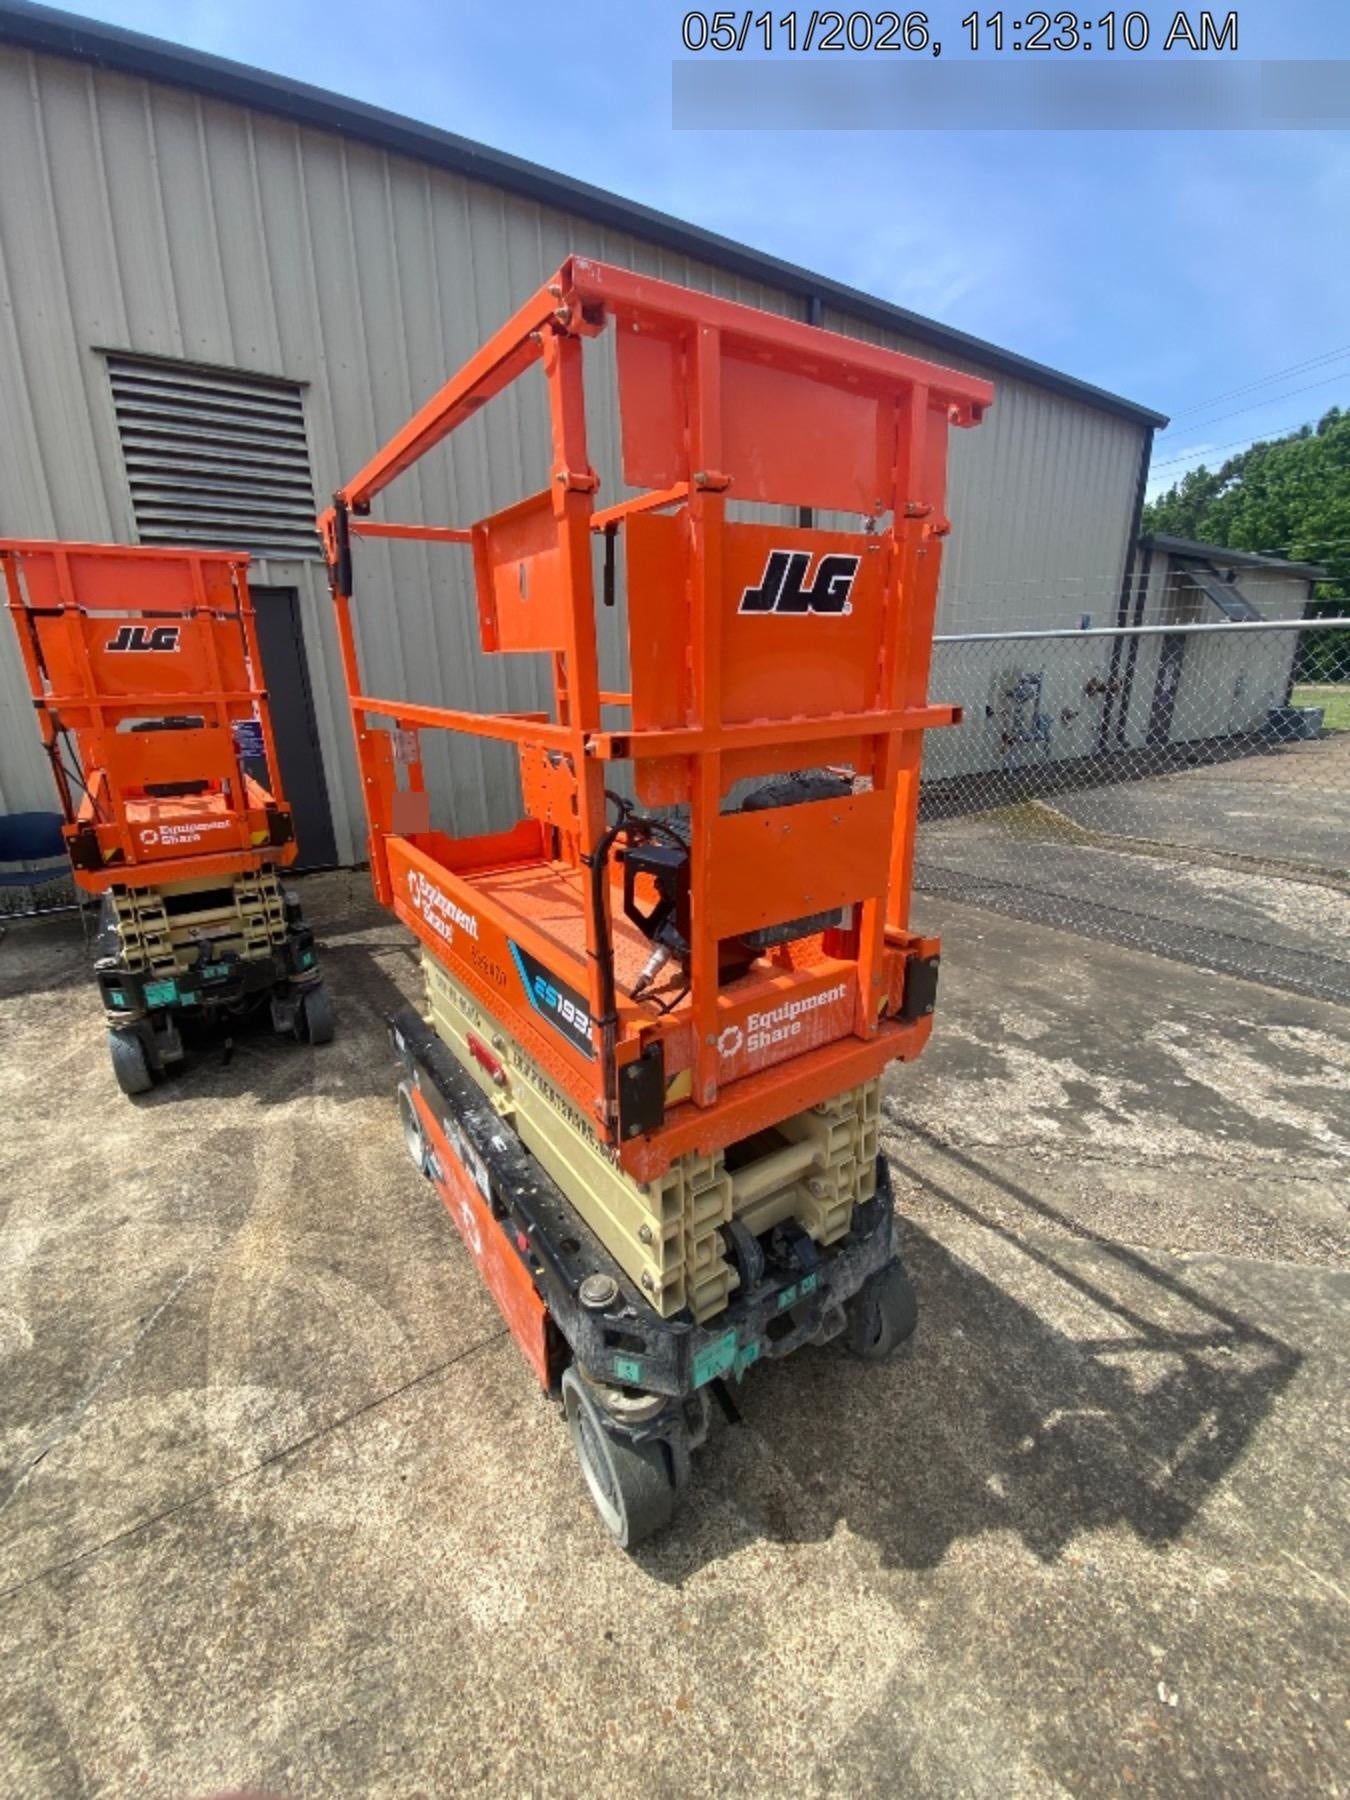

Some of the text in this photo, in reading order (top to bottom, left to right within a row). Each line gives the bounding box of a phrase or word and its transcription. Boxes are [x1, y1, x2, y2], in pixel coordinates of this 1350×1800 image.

[737, 549, 861, 616] JLG
[104, 625, 181, 653] JLG
[747, 983, 847, 1032] Equipment
[747, 1021, 801, 1053] Share
